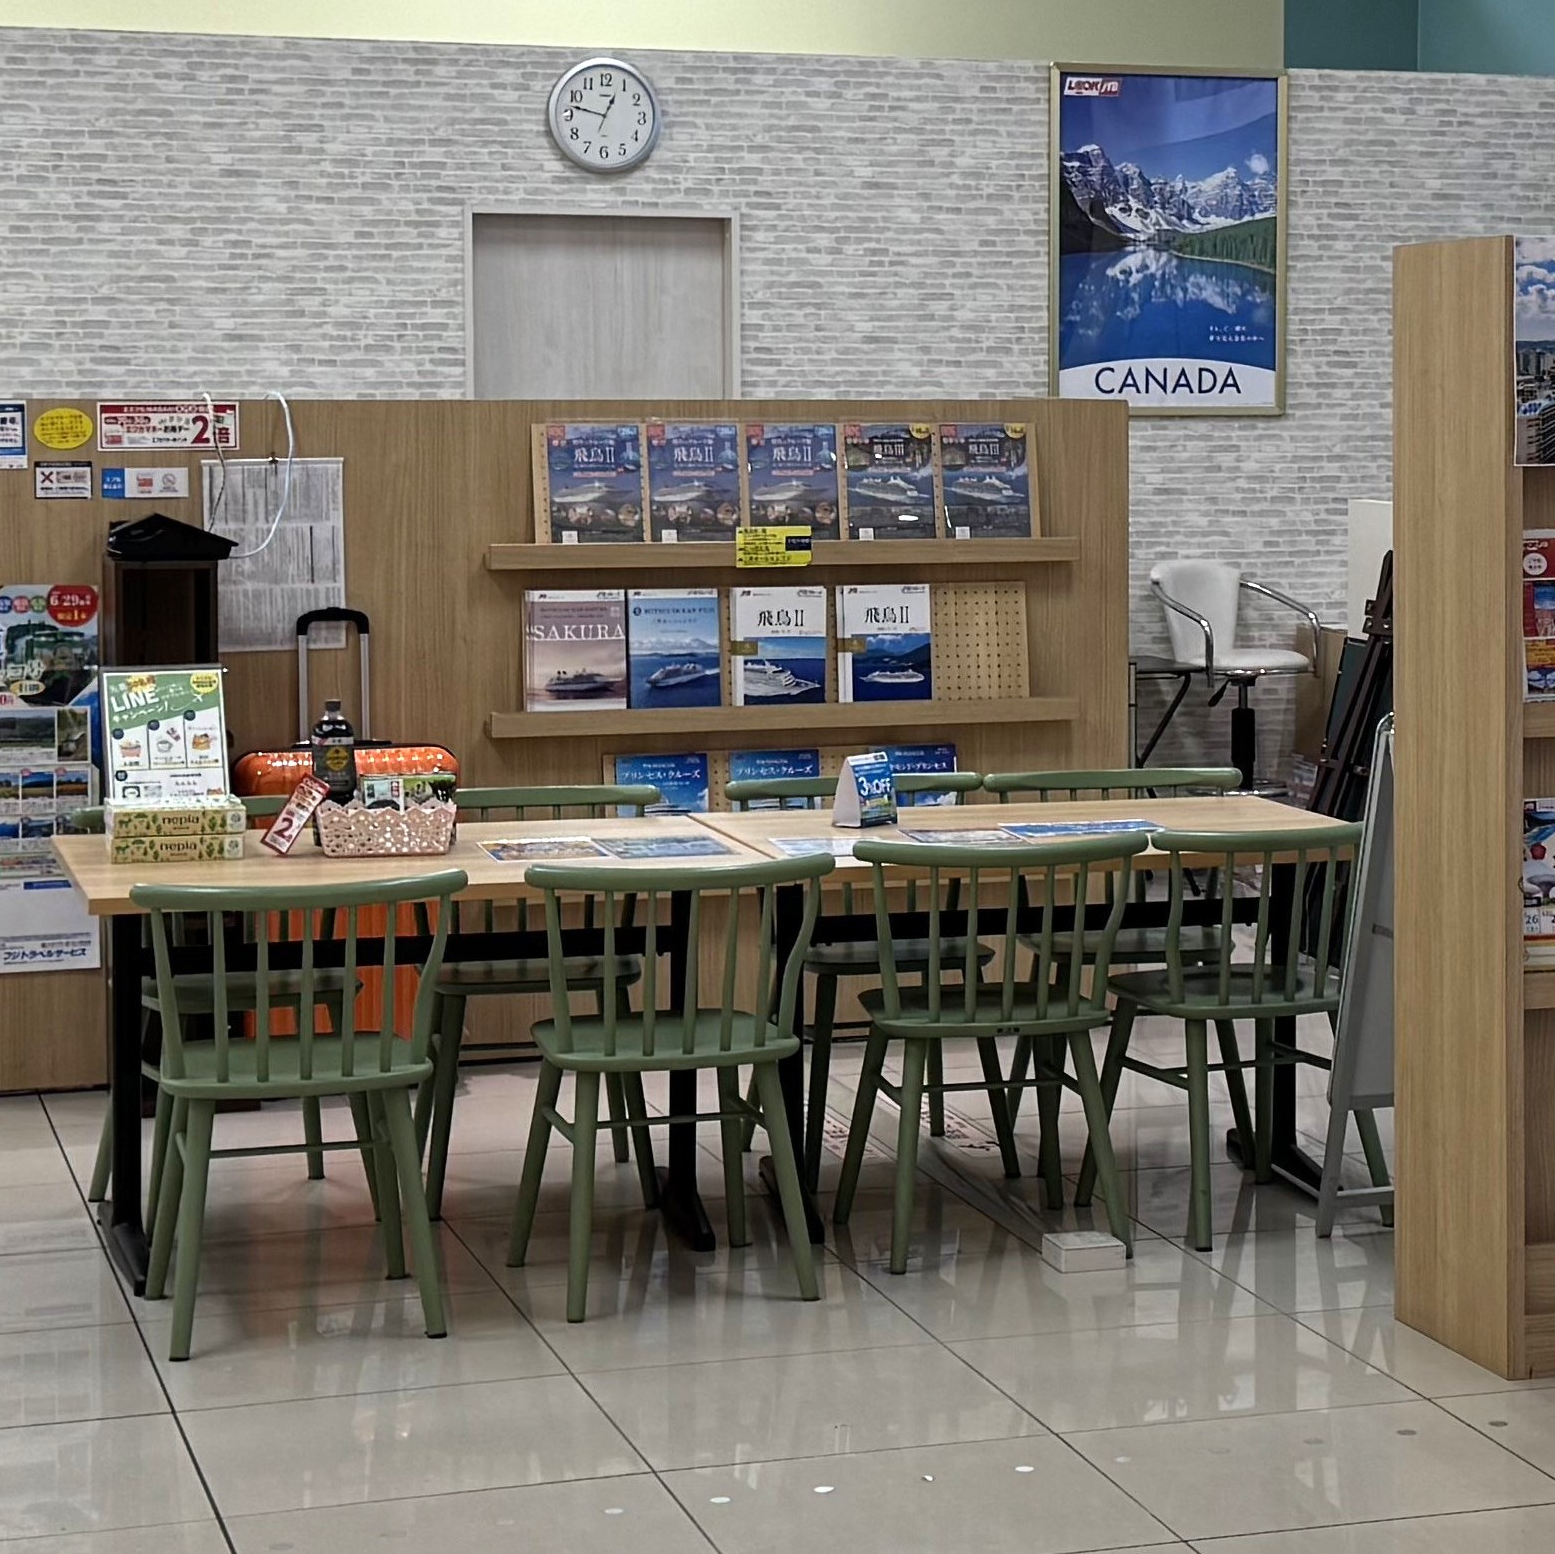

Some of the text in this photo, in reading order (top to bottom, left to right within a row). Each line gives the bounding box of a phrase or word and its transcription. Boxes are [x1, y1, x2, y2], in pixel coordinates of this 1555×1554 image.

[583, 77, 593, 90] 11
[600, 73, 612, 86] 12
[622, 78, 626, 92] 1
[570, 90, 583, 103] 10
[632, 93, 641, 106] 2
[564, 108, 574, 121] 9
[637, 112, 646, 125] 3
[570, 127, 579, 140] 8
[631, 130, 639, 142] 4
[583, 141, 591, 154] 7
[599, 146, 608, 159] 6
[618, 143, 626, 156] 5
[1094, 366, 1242, 395] CANADA
[534, 624, 625, 641] SAKURA
[110, 688, 160, 713] LINE
[162, 813, 199, 826] nepia
[159, 841, 198, 852] nepia
